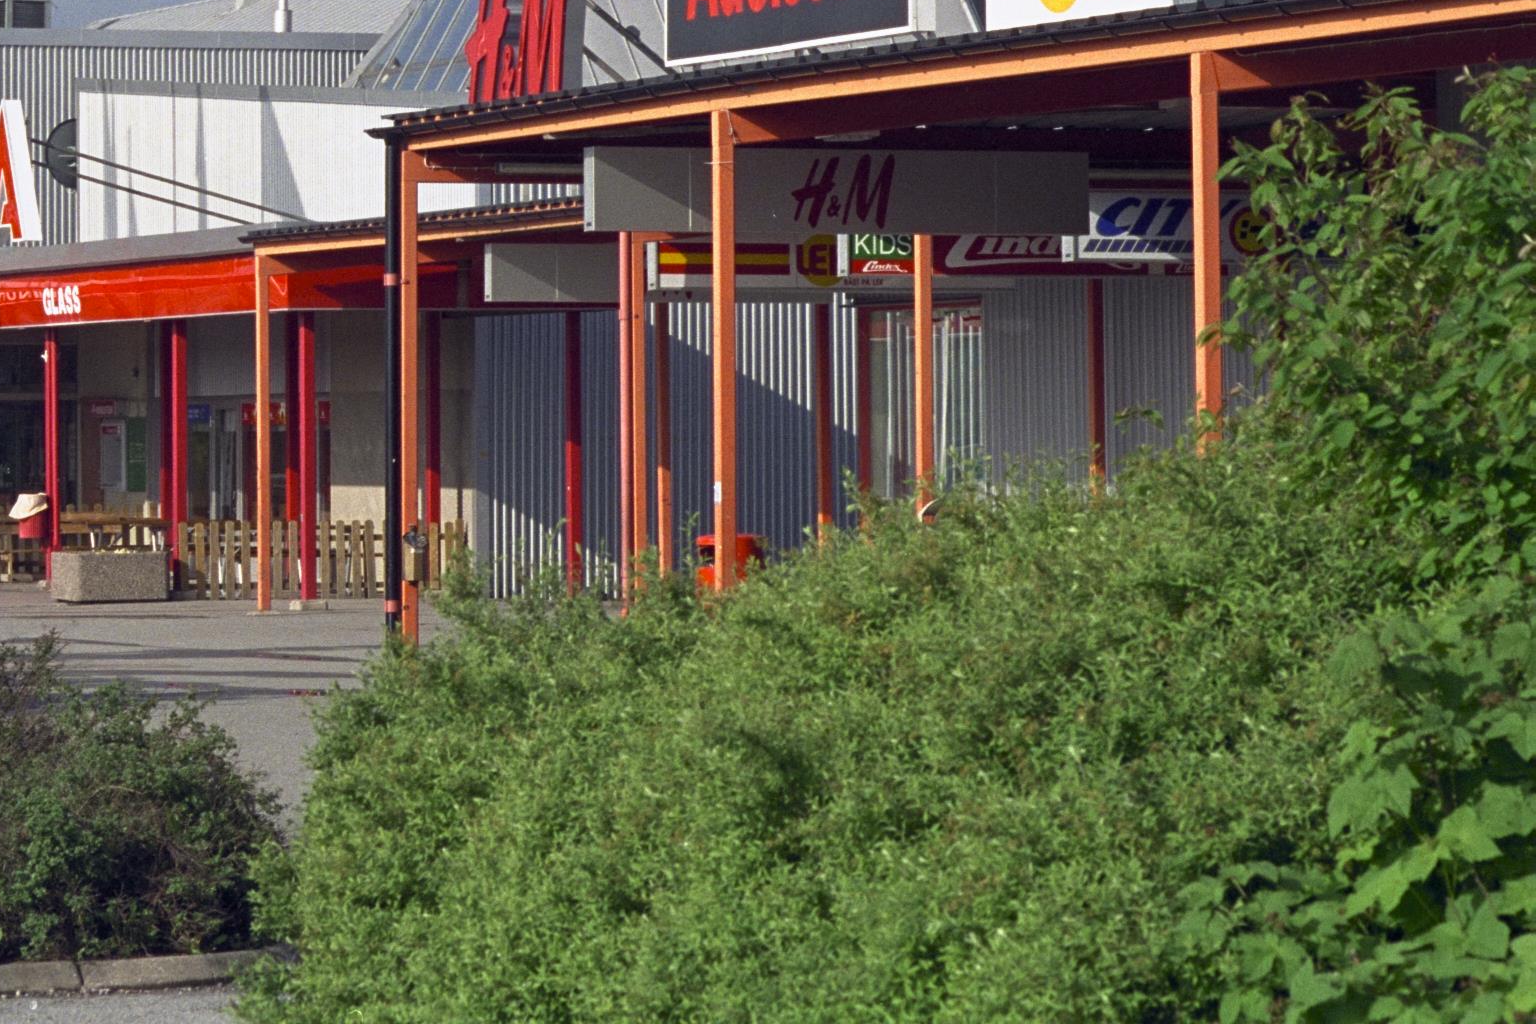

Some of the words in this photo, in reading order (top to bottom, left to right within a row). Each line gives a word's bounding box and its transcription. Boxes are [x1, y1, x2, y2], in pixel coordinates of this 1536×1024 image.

[791, 154, 895, 229] H&M
[1095, 197, 1242, 237] CIT
[854, 233, 912, 256] KIDS
[42, 285, 81, 316] GLASS
